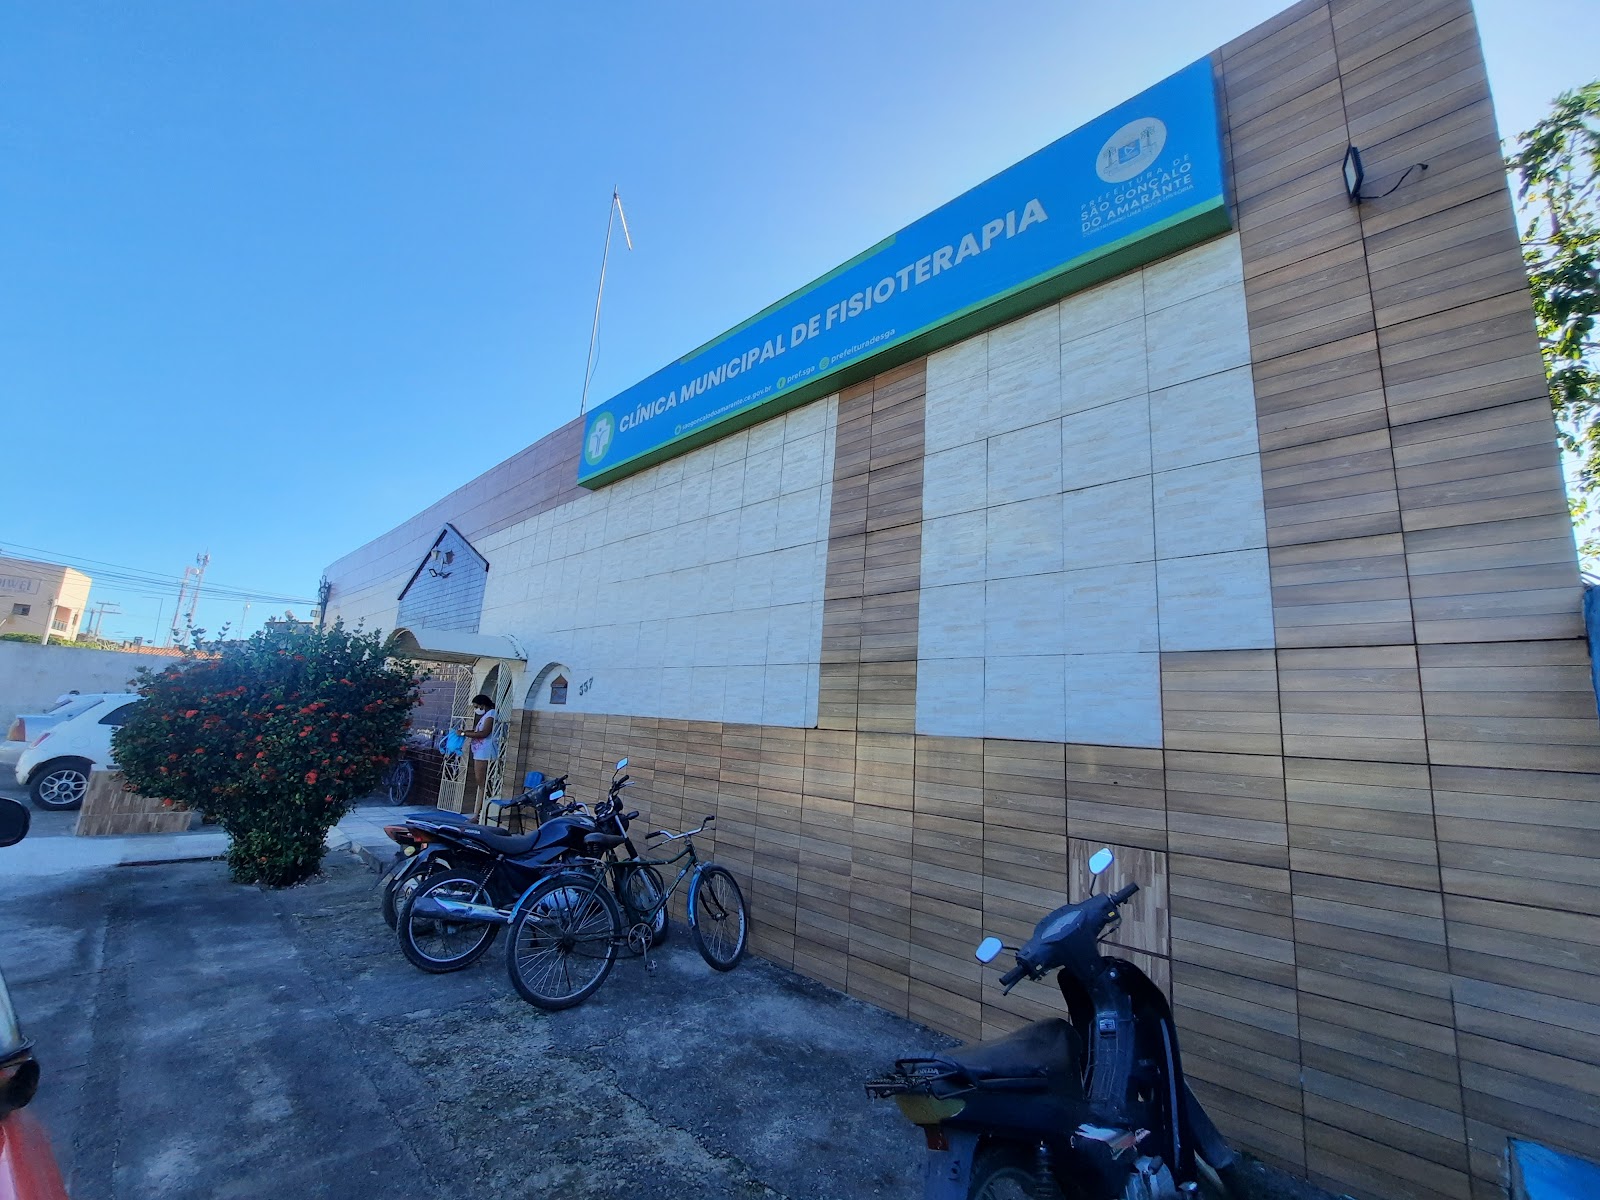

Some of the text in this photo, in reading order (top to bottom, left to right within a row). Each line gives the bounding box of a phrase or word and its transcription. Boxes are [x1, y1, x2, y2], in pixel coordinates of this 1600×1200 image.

[1081, 153, 1189, 210] PREFEITURA DE
[1081, 162, 1192, 221] SÃO GONÇALO
[1082, 173, 1192, 232] DO AMARANTE
[619, 198, 1049, 433] CLÍNICA MUNICIPAL DE FISIOTERAPIA
[787, 365, 816, 384] pref.sga
[830, 328, 896, 363] prefeituradesga
